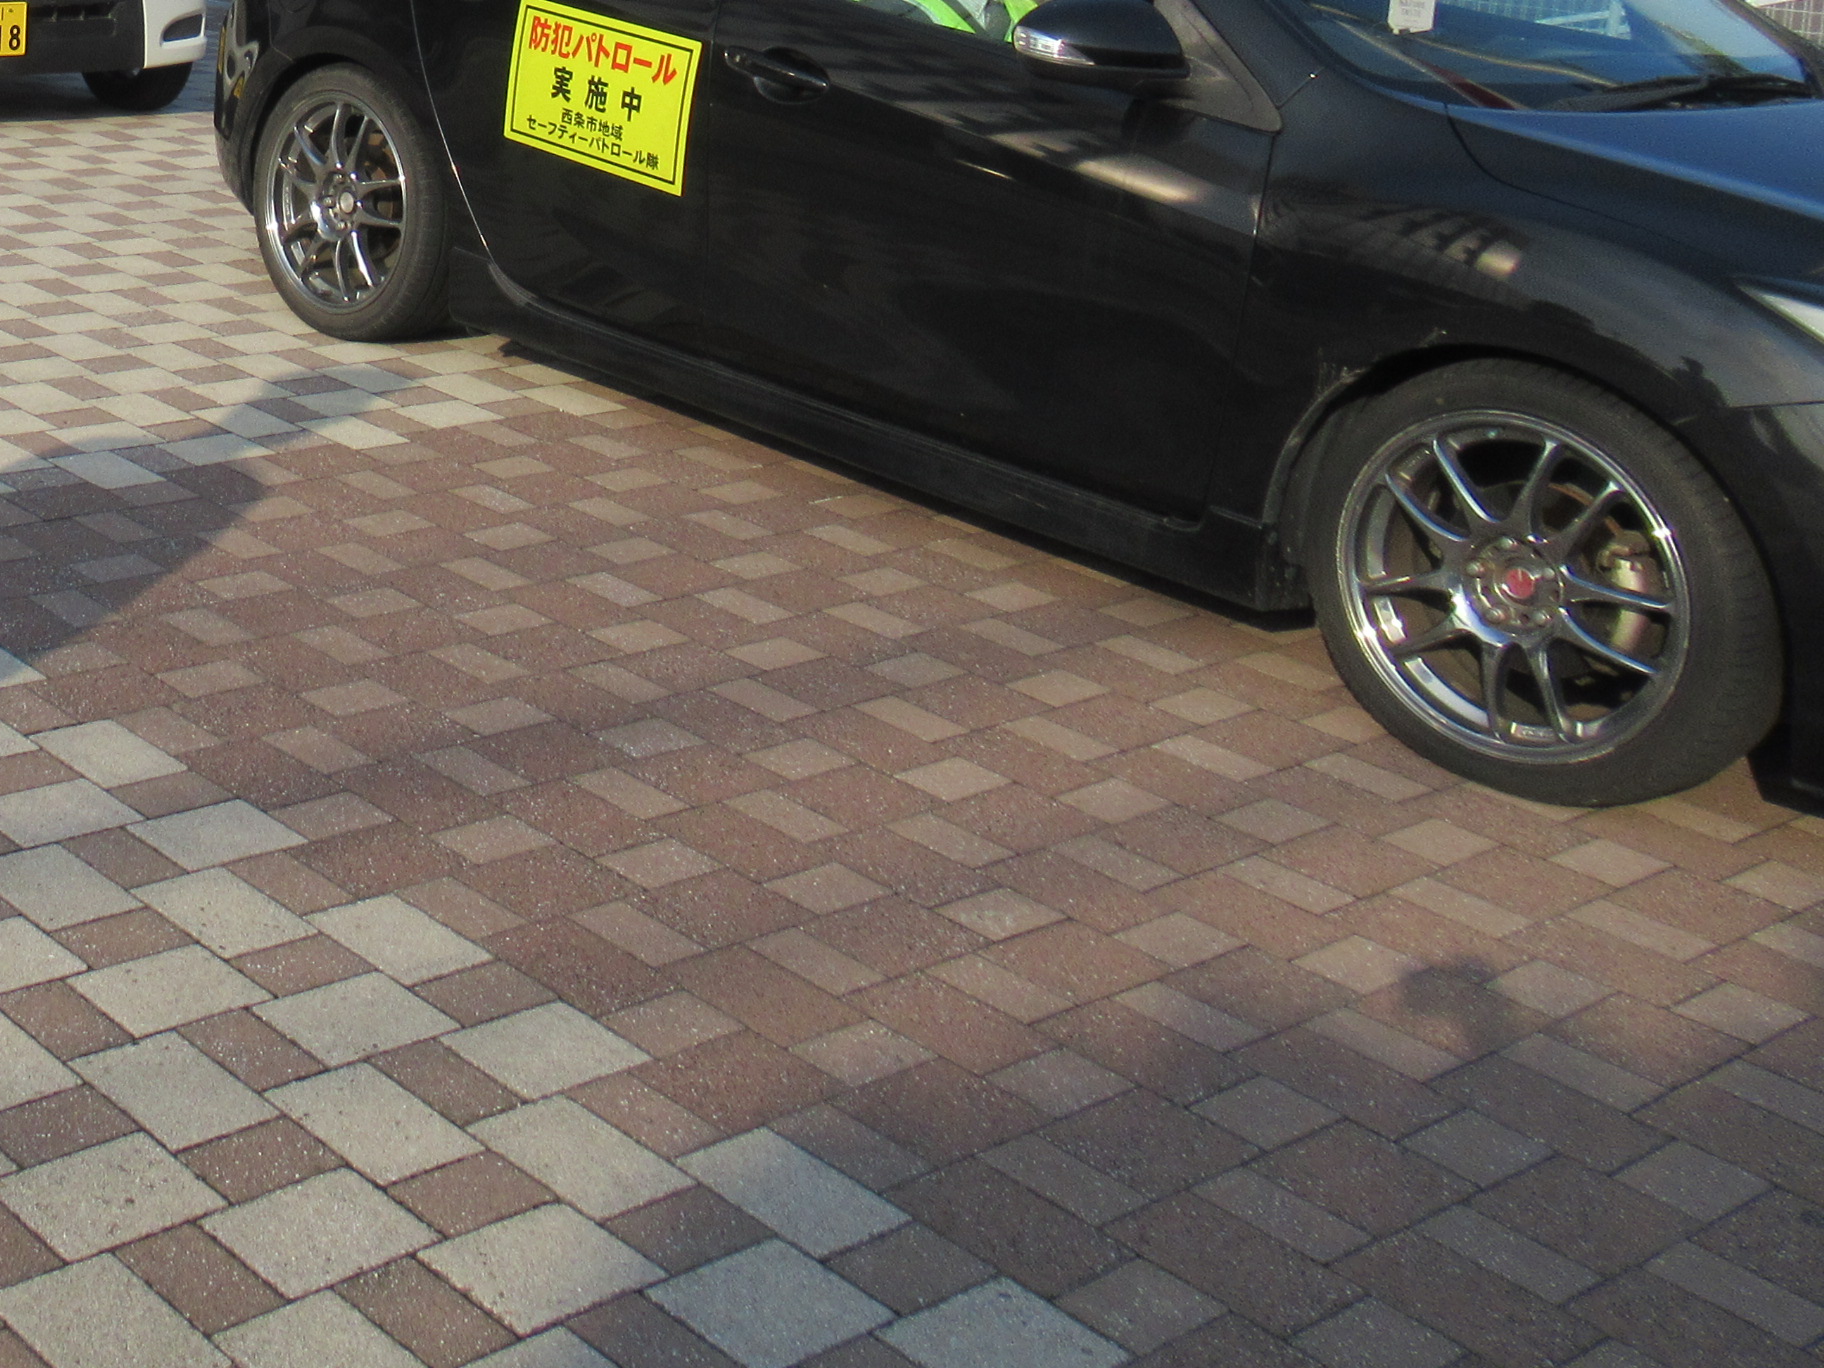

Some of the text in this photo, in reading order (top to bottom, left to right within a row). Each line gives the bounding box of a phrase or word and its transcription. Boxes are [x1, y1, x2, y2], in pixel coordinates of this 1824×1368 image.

[529, 15, 677, 86] 防犯パトロール
[551, 66, 643, 122] 実施中
[526, 114, 659, 171] セーフティーパトロール隊
[562, 108, 624, 142] 西条市地域
